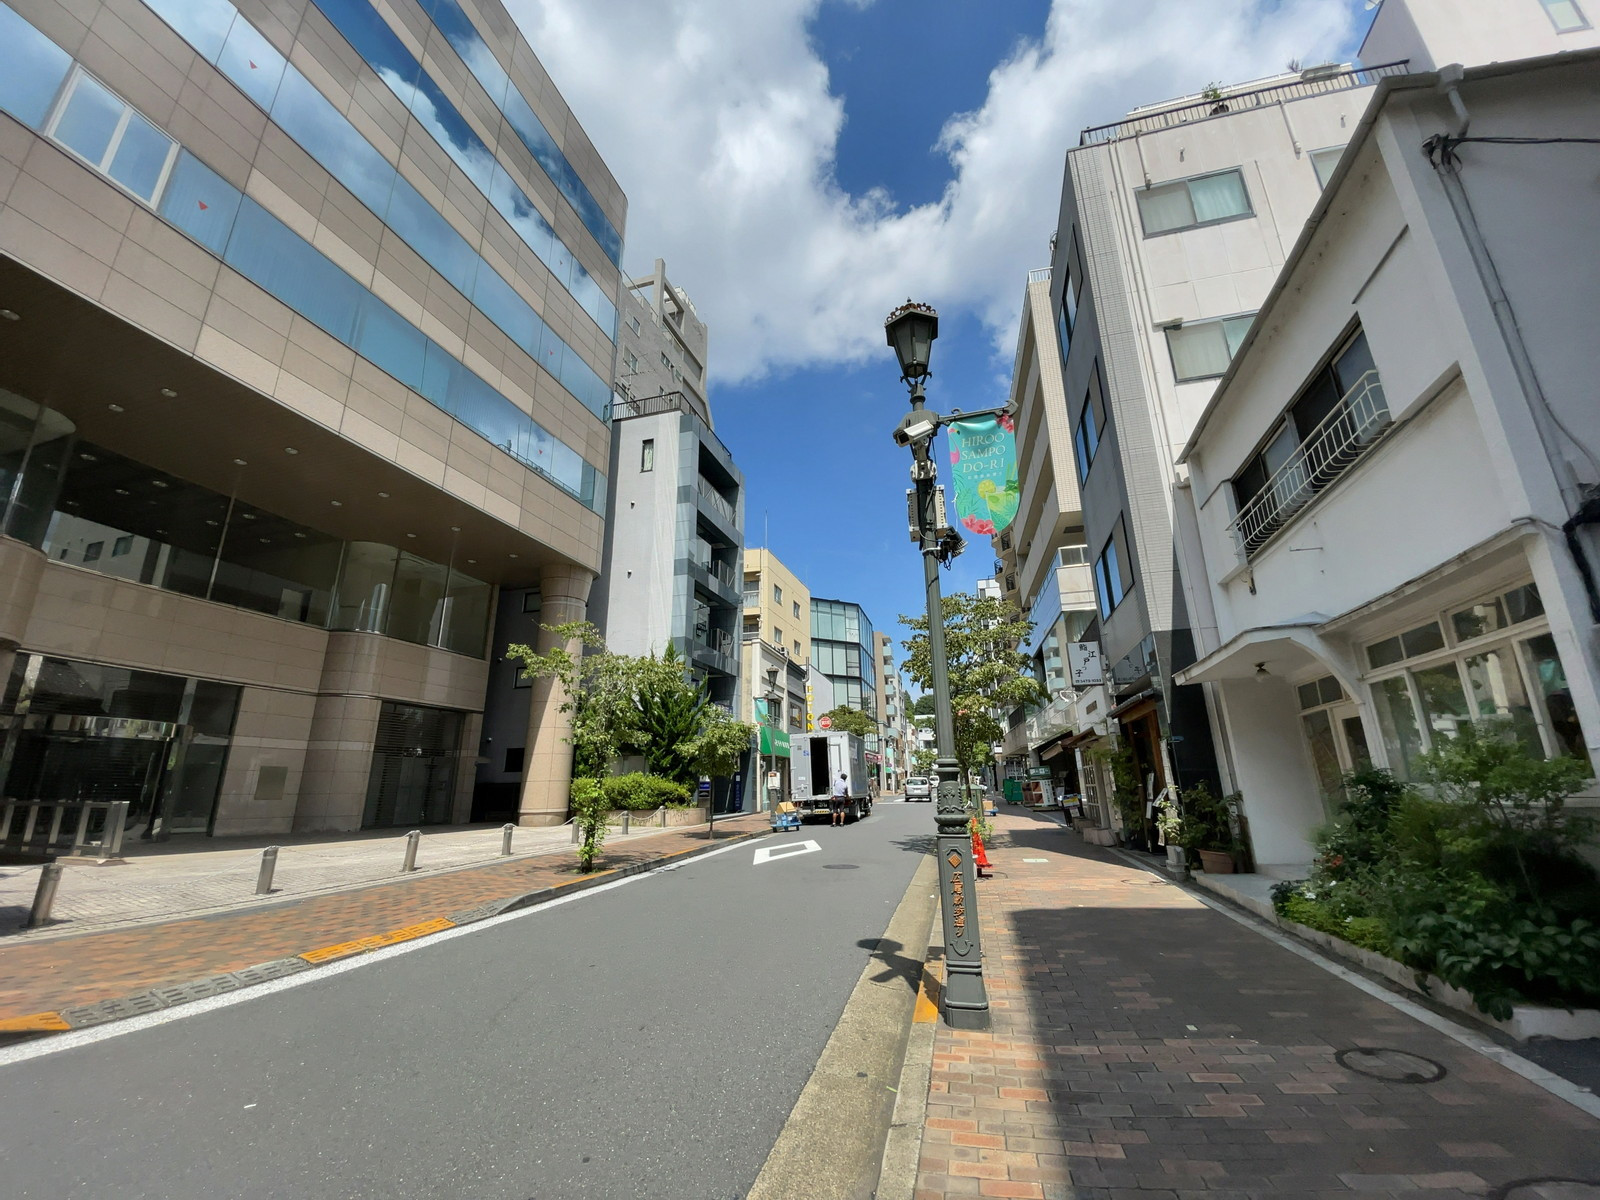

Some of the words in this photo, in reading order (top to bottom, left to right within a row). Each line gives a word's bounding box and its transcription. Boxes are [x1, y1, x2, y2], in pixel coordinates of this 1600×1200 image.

[962, 433, 1004, 447] HIROO
[962, 446, 1005, 460] SAMPO
[963, 458, 1004, 472] DO-RI
[806, 686, 815, 734] POTON
